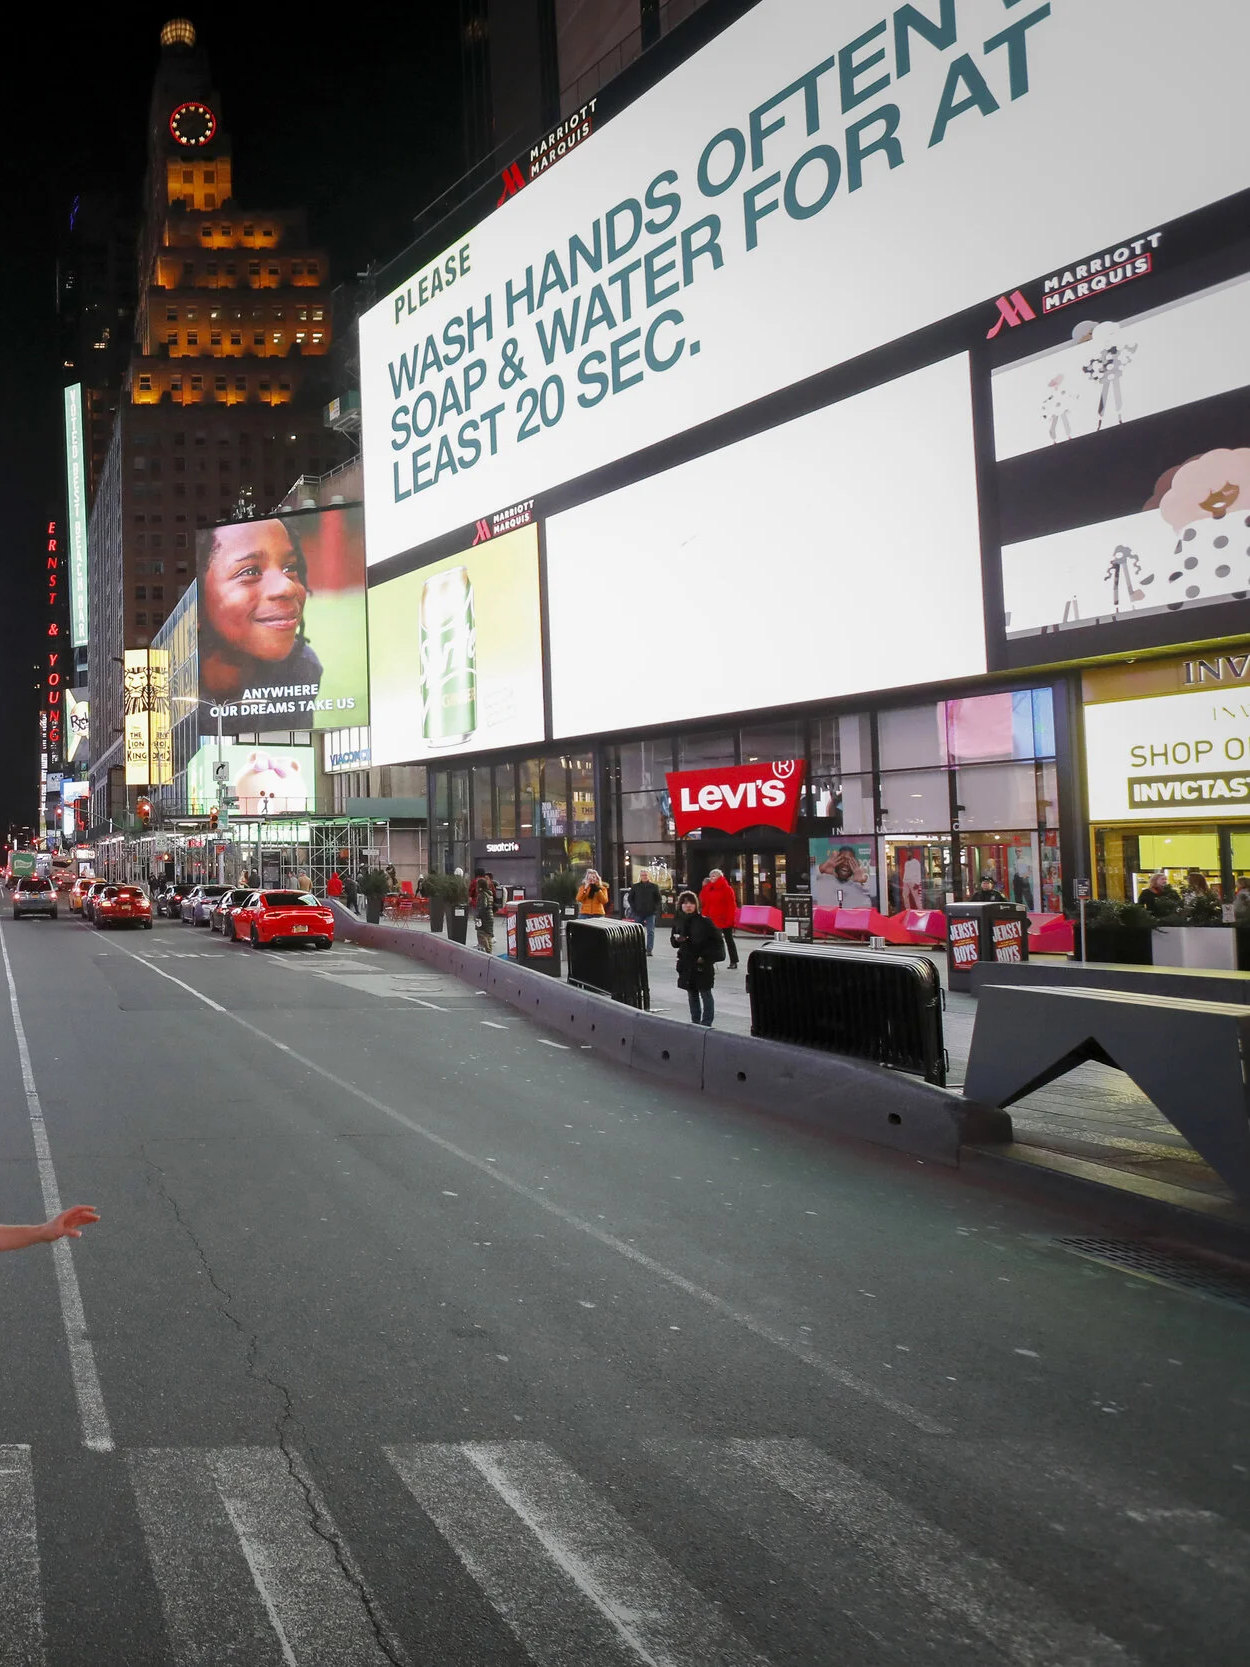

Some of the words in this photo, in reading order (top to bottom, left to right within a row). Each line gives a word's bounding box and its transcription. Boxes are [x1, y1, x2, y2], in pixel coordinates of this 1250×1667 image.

[530, 97, 597, 162] MARRIOTT
[530, 122, 591, 178] MARQUIS
[388, 293, 493, 400] WASH
[506, 170, 682, 328] HANDS
[697, 0, 957, 198] OFTEN
[391, 357, 487, 451] SOAP
[498, 337, 527, 390] &
[535, 213, 725, 366] WATER
[742, 103, 905, 252] FOR
[927, 7, 1052, 150] AT
[1044, 231, 1164, 293] MARRIOTT
[394, 243, 472, 325] PLEASE
[1045, 255, 1149, 310] MARQUIS
[393, 403, 506, 504] LEAST
[516, 373, 565, 443] 20
[577, 308, 701, 408] SEC.
[493, 499, 535, 524] MARRIOTT
[493, 512, 530, 534] MARQUIS
[47, 521, 61, 606] ERNST
[77, 593, 86, 638] BAR
[49, 622, 60, 636] &
[48, 653, 61, 743] YOUNG
[242, 683, 319, 700] ANYWHERE
[210, 705, 238, 717] OUR
[241, 701, 296, 716] DREAMS
[298, 698, 333, 712] TAKE
[337, 698, 355, 709] US
[127, 750, 147, 761] KING
[128, 739, 145, 749] LION
[1130, 740, 1214, 768] SHOP
[1224, 736, 1250, 761] O
[1133, 776, 1250, 803] INVICTAS
[486, 842, 515, 852] swatch
[526, 913, 554, 933] JERSEY
[950, 920, 980, 941] JERSEY
[992, 921, 1022, 943] JERSEY
[529, 934, 553, 952] BOYS
[953, 944, 978, 964] BOYS
[996, 945, 1021, 962] BOYS
